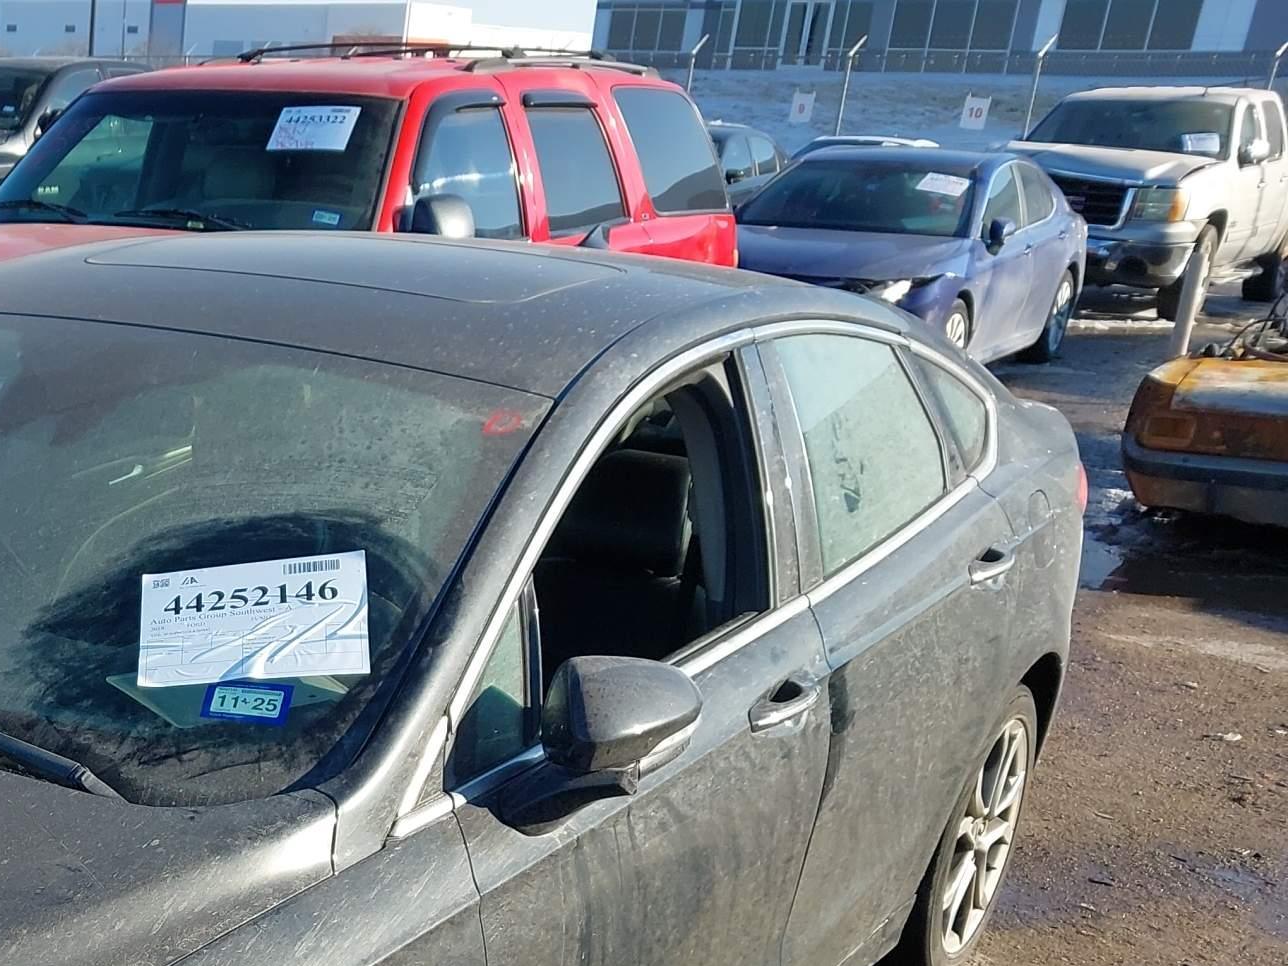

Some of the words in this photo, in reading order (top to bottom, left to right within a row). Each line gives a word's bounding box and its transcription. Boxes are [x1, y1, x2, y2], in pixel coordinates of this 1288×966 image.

[968, 106, 983, 119] 10
[163, 578, 339, 616] 44252146
[150, 616, 172, 626] Auto
[174, 614, 197, 624] Parts
[198, 611, 228, 621] Group
[229, 606, 276, 617] Southwest
